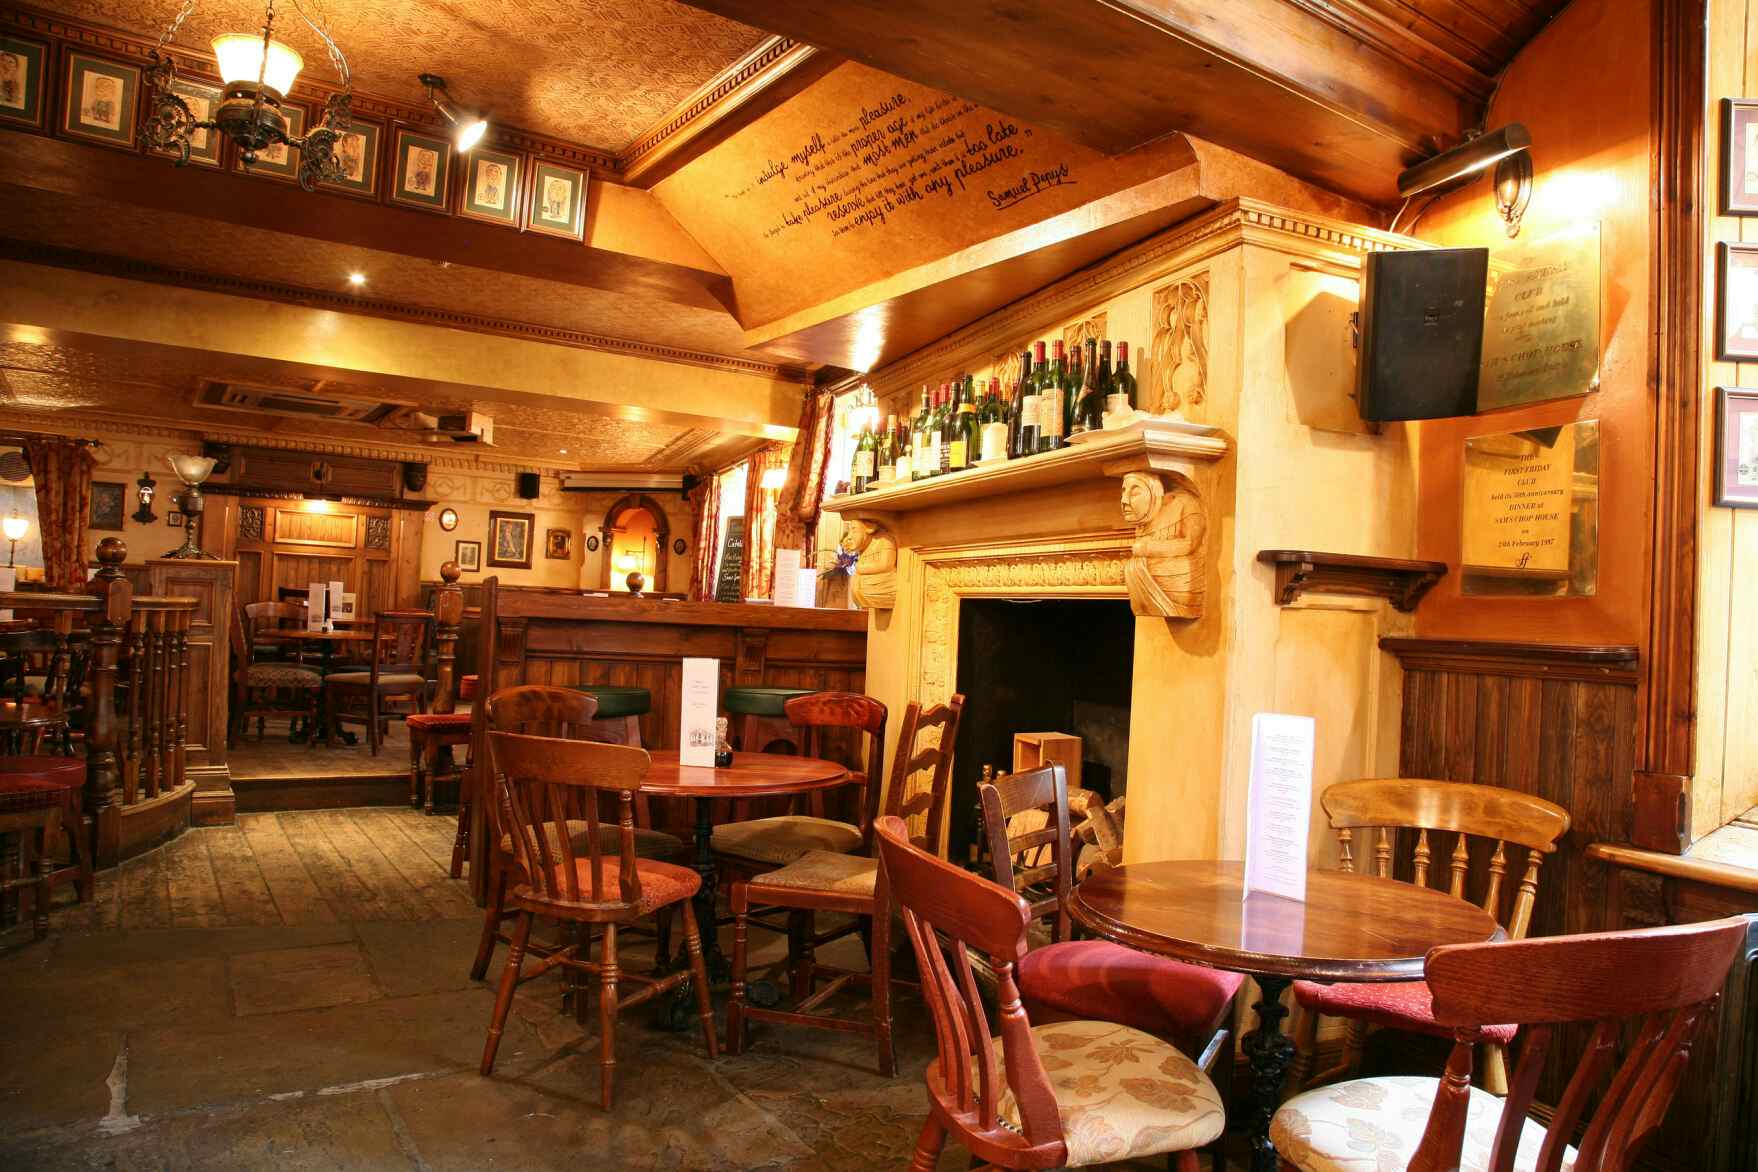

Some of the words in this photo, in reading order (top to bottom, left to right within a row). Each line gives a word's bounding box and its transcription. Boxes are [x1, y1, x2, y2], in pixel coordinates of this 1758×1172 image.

[791, 133, 826, 166] myself
[851, 129, 886, 157] proper
[887, 117, 908, 135] age
[863, 140, 892, 167] most
[827, 194, 866, 222] reserve
[964, 139, 988, 155] too
[986, 120, 1018, 145] late
[986, 177, 1031, 207] Samuel
[1029, 162, 1069, 191] Pepys
[803, 193, 842, 223] pleasure
[854, 206, 886, 225] enjoy
[883, 196, 895, 212] it
[896, 185, 923, 207] with
[925, 175, 953, 197] any
